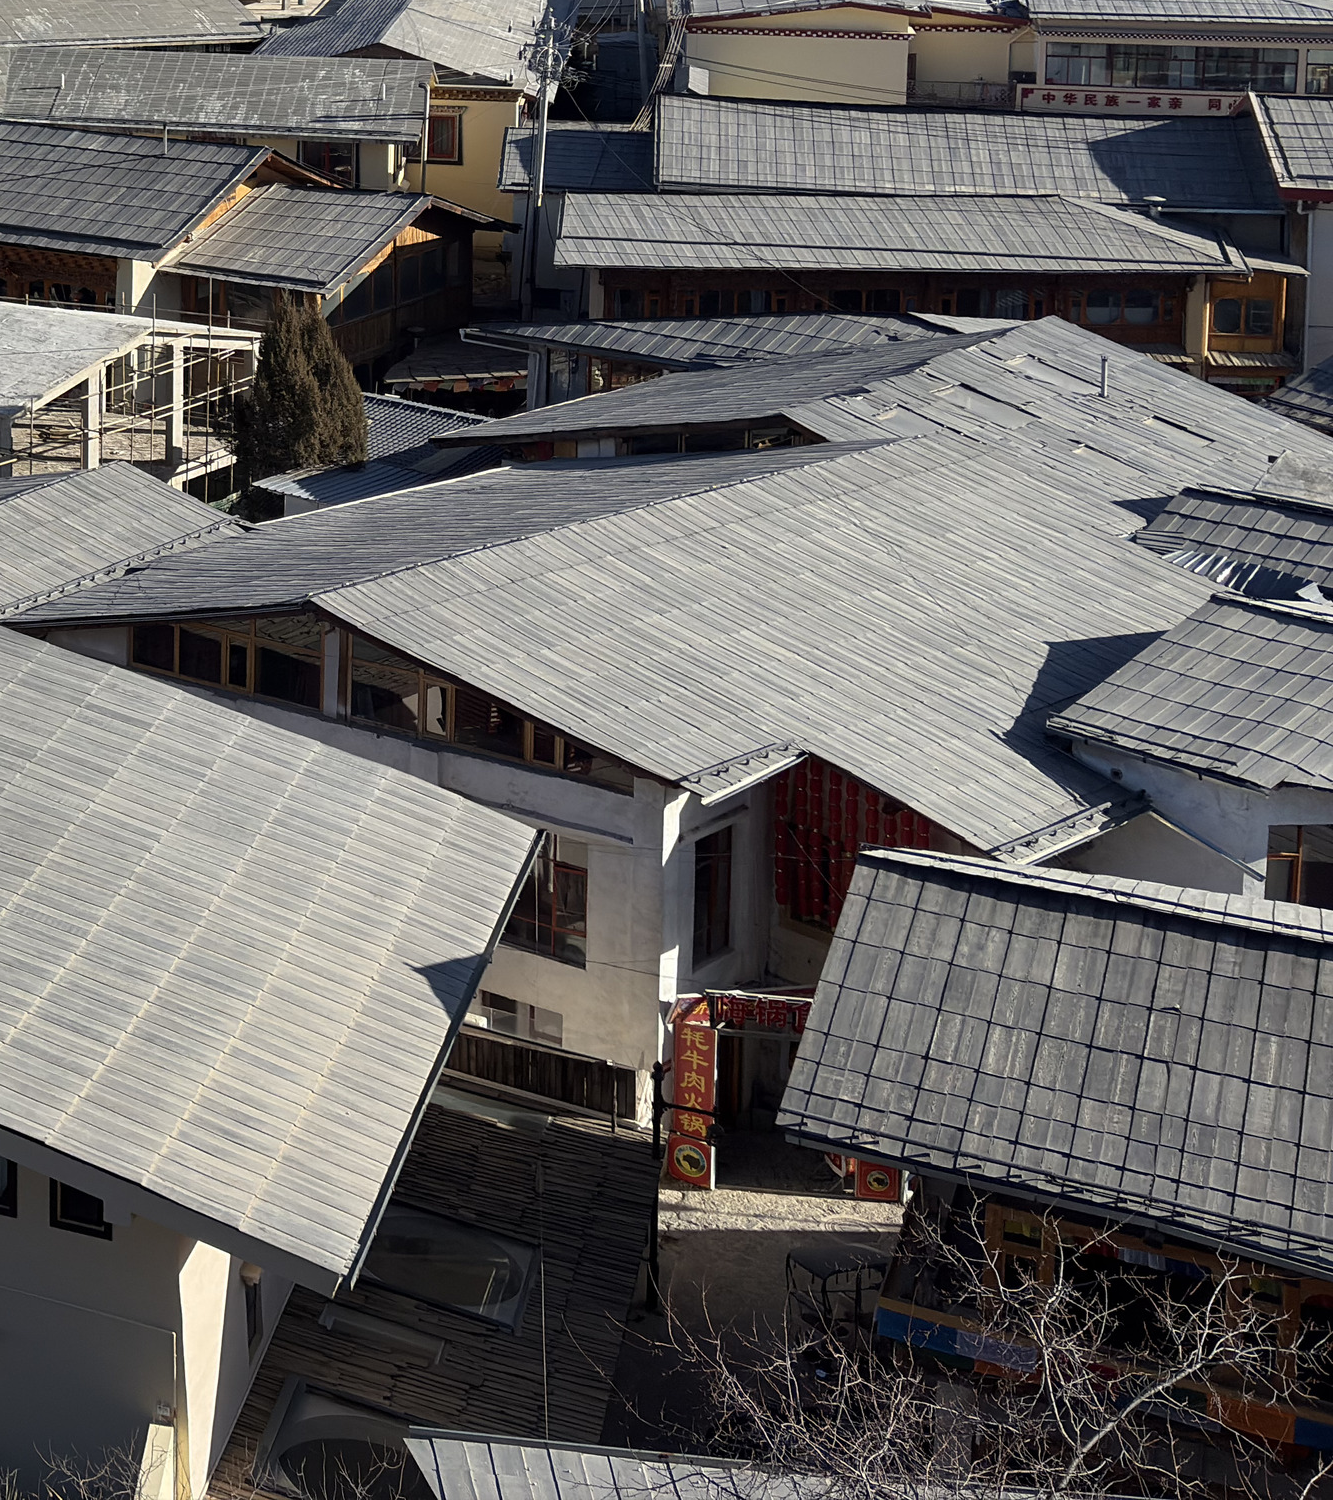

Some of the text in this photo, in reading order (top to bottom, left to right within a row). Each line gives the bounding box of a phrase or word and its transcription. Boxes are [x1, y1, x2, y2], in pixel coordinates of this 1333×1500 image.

[1042, 92, 1183, 110] 中华民族一家亲
[678, 1027, 710, 1138] 牦牛肉火锅
